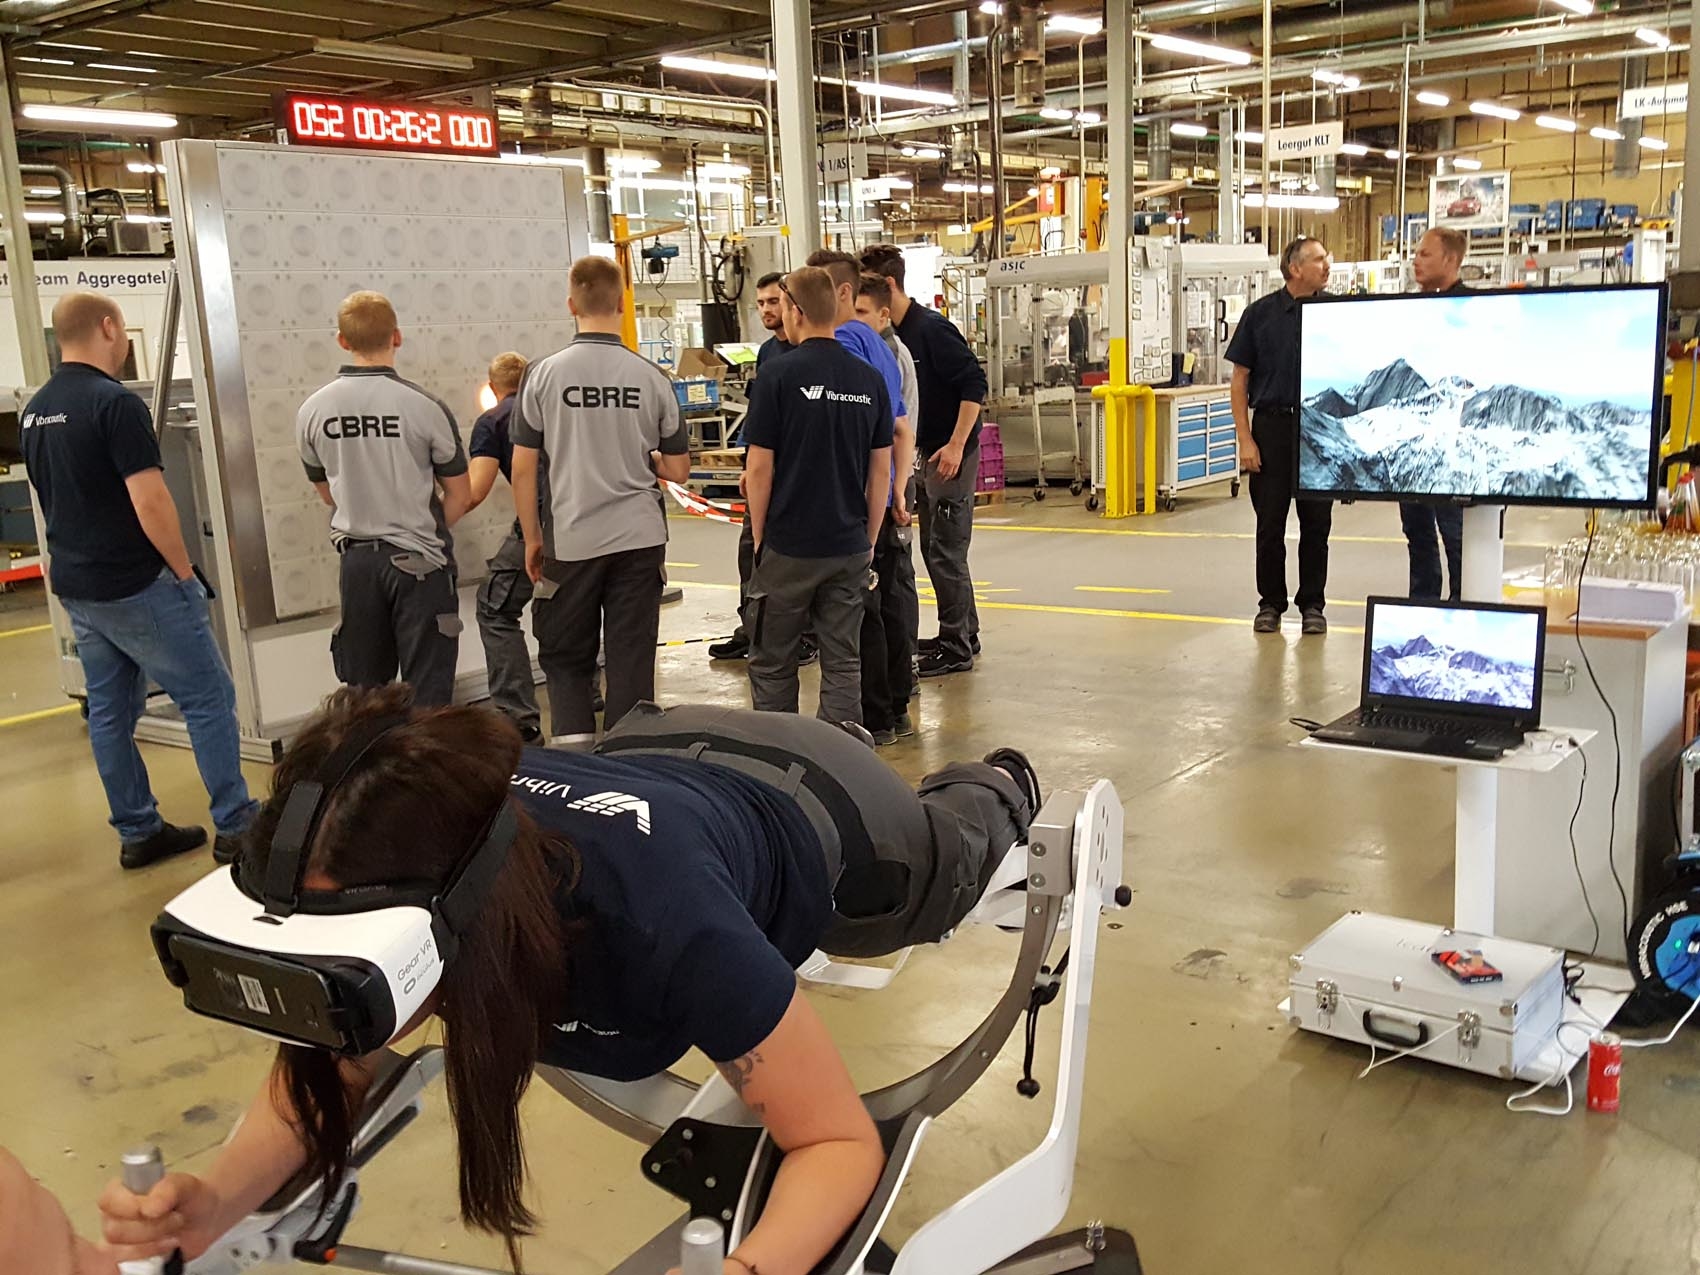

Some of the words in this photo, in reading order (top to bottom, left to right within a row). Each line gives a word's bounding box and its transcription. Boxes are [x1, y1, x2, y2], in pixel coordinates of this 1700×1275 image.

[293, 102, 345, 138] 052
[352, 107, 442, 145] 00:26:2
[448, 115, 493, 148] 000
[1278, 138, 1312, 151] Leergut
[1314, 134, 1330, 147] KLT
[34, 274, 69, 286] eam
[561, 385, 641, 410] CBRE
[825, 389, 872, 405] Vibracoustic
[322, 415, 401, 440] CBRE
[510, 774, 572, 799] Vibr
[397, 952, 420, 981] Gear
[420, 938, 432, 956] VR
